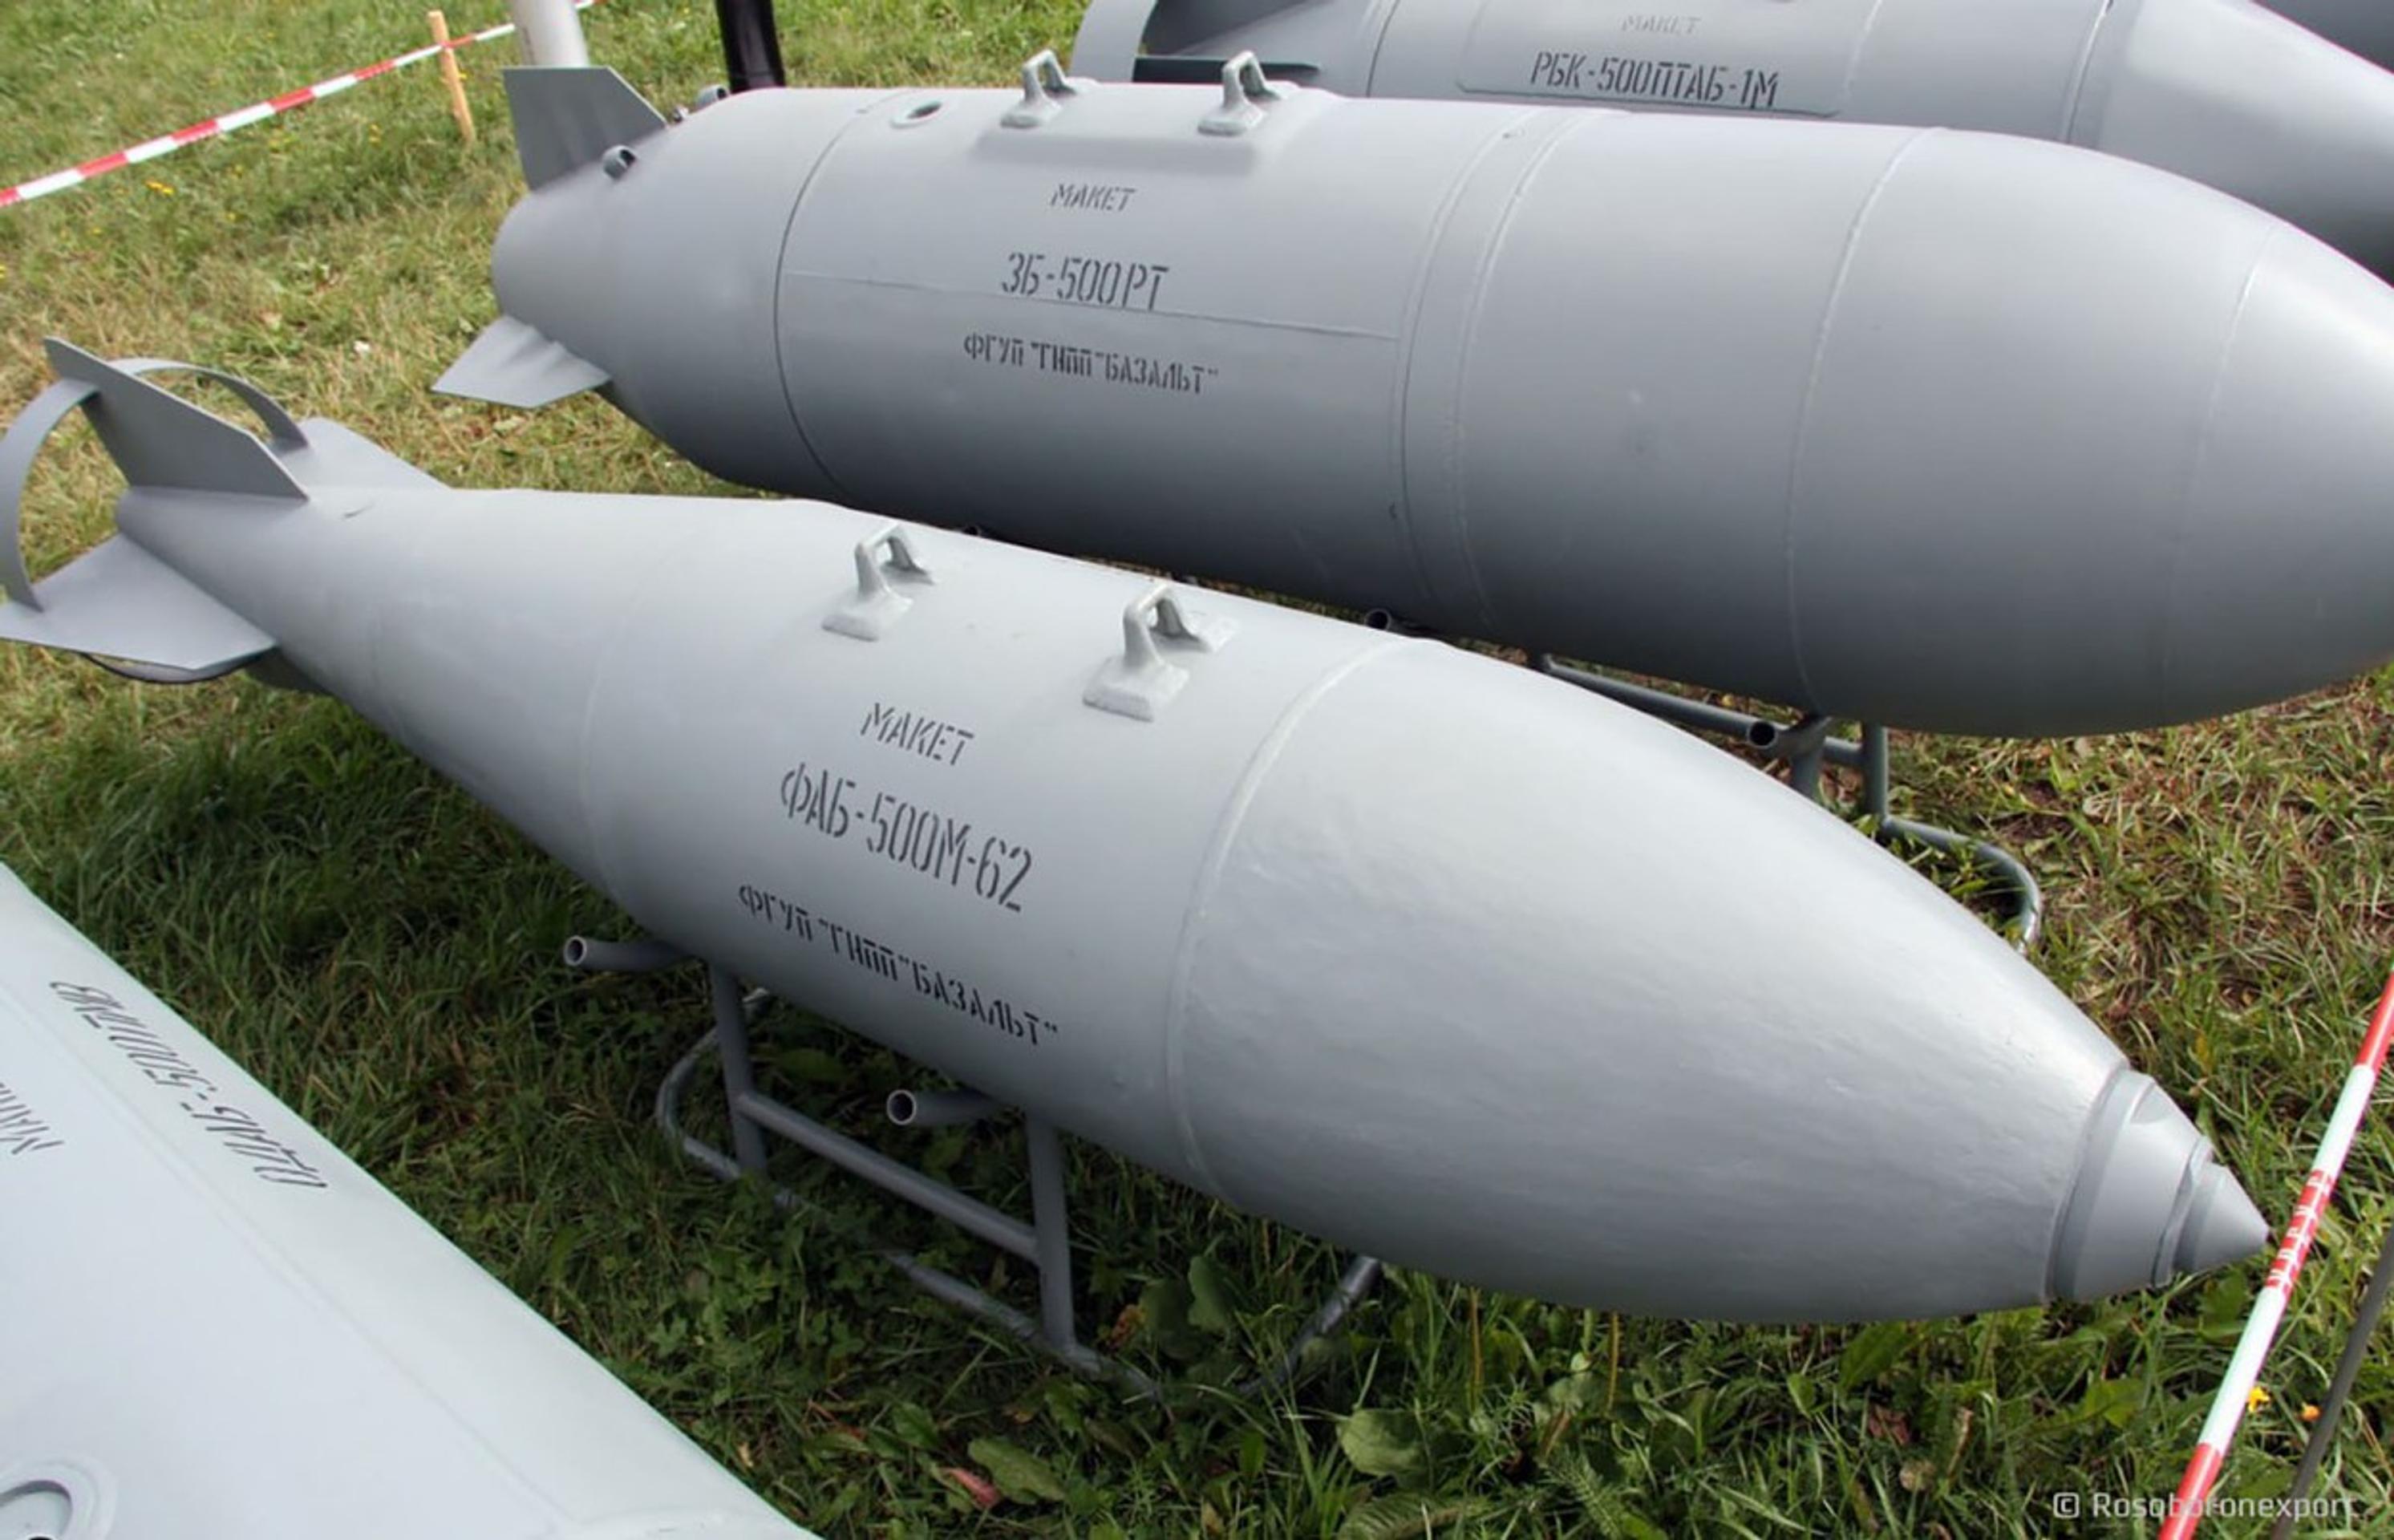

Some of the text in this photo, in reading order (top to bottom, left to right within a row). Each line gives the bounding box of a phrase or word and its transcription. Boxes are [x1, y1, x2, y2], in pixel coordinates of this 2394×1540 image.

[1529, 51, 1779, 110] РБК-500ПТАБ-1М
[1050, 183, 1137, 212] МАКЕТ
[1001, 251, 1170, 311] ЗБ-500РТ
[963, 332, 1024, 367] ФГУП
[860, 702, 974, 766] МАКЕТ
[780, 763, 1032, 913] ФАБ-500М-62
[738, 884, 814, 943] ФГУП
